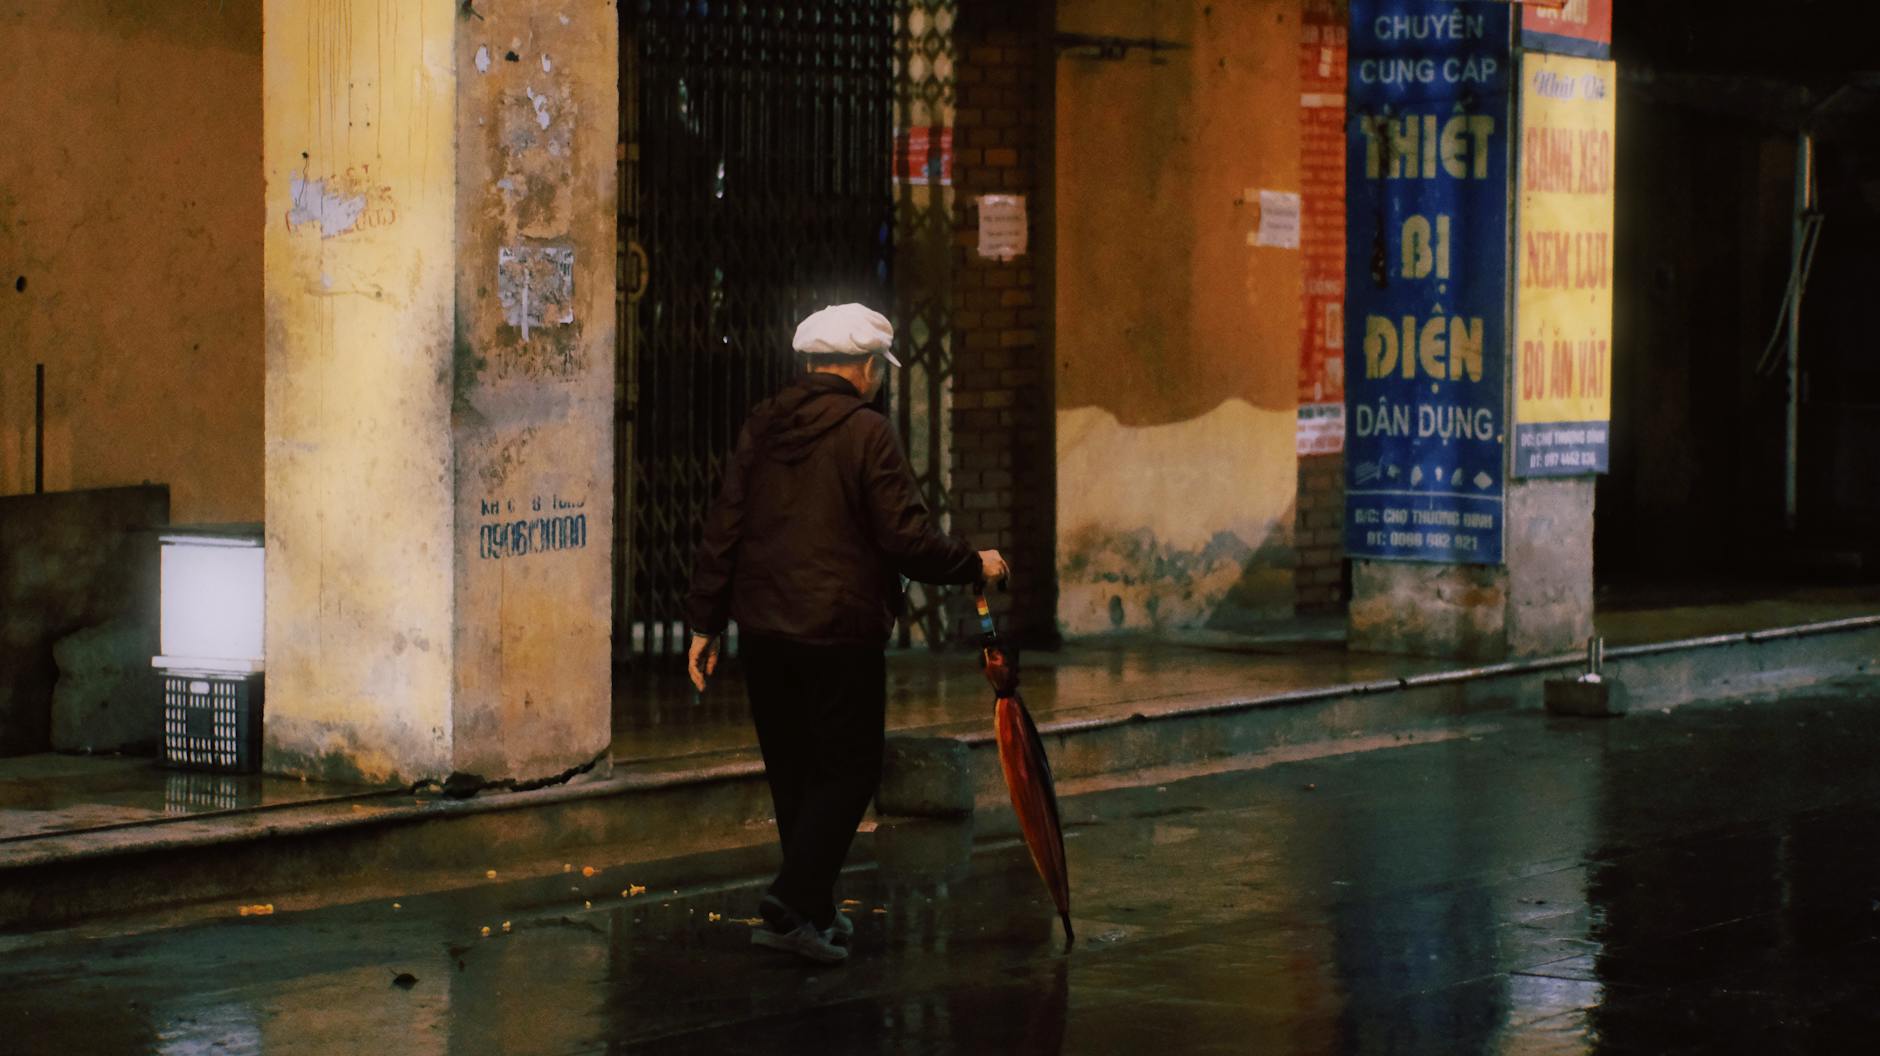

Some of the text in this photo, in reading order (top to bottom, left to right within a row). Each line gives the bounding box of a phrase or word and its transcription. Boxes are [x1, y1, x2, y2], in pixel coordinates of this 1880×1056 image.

[1374, 8, 1484, 41] CHUYÊN
[1360, 58, 1435, 84] CUNG
[1360, 100, 1496, 180] THIẾT
[1400, 213, 1452, 294] BỊ
[1526, 230, 1570, 290] NEM
[1363, 302, 1484, 394] ĐIỆN
[1356, 396, 1410, 438] DÂN
[1418, 405, 1494, 446] DỤNG
